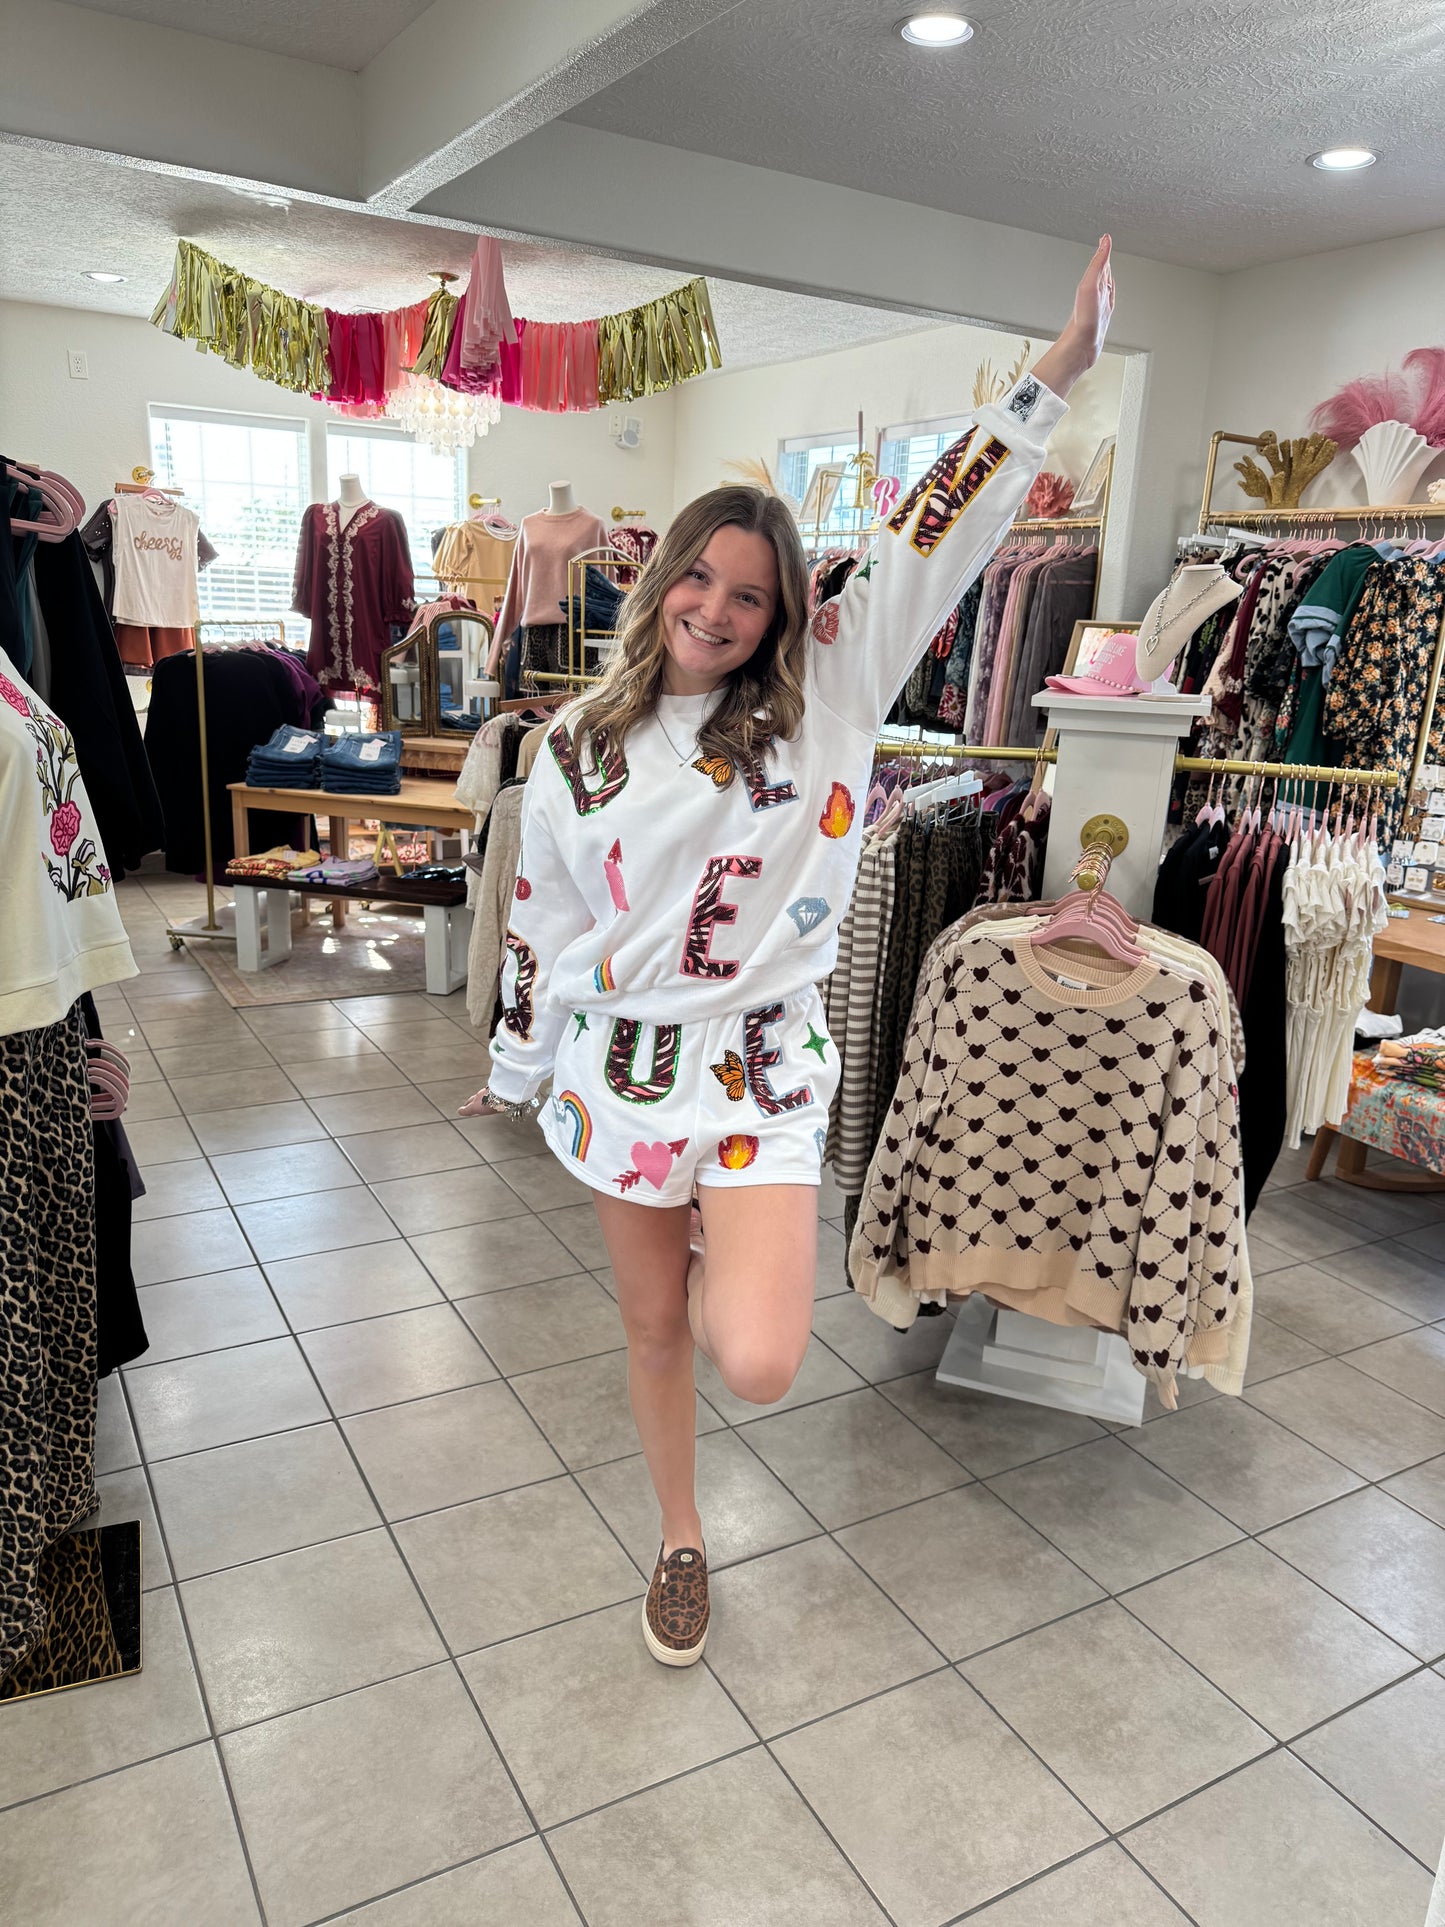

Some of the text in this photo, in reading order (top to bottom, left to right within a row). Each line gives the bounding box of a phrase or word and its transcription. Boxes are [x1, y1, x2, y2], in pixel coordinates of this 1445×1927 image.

[134, 530, 182, 560] cheers!
[679, 855, 763, 980] E
[604, 1001, 814, 1119] U E
